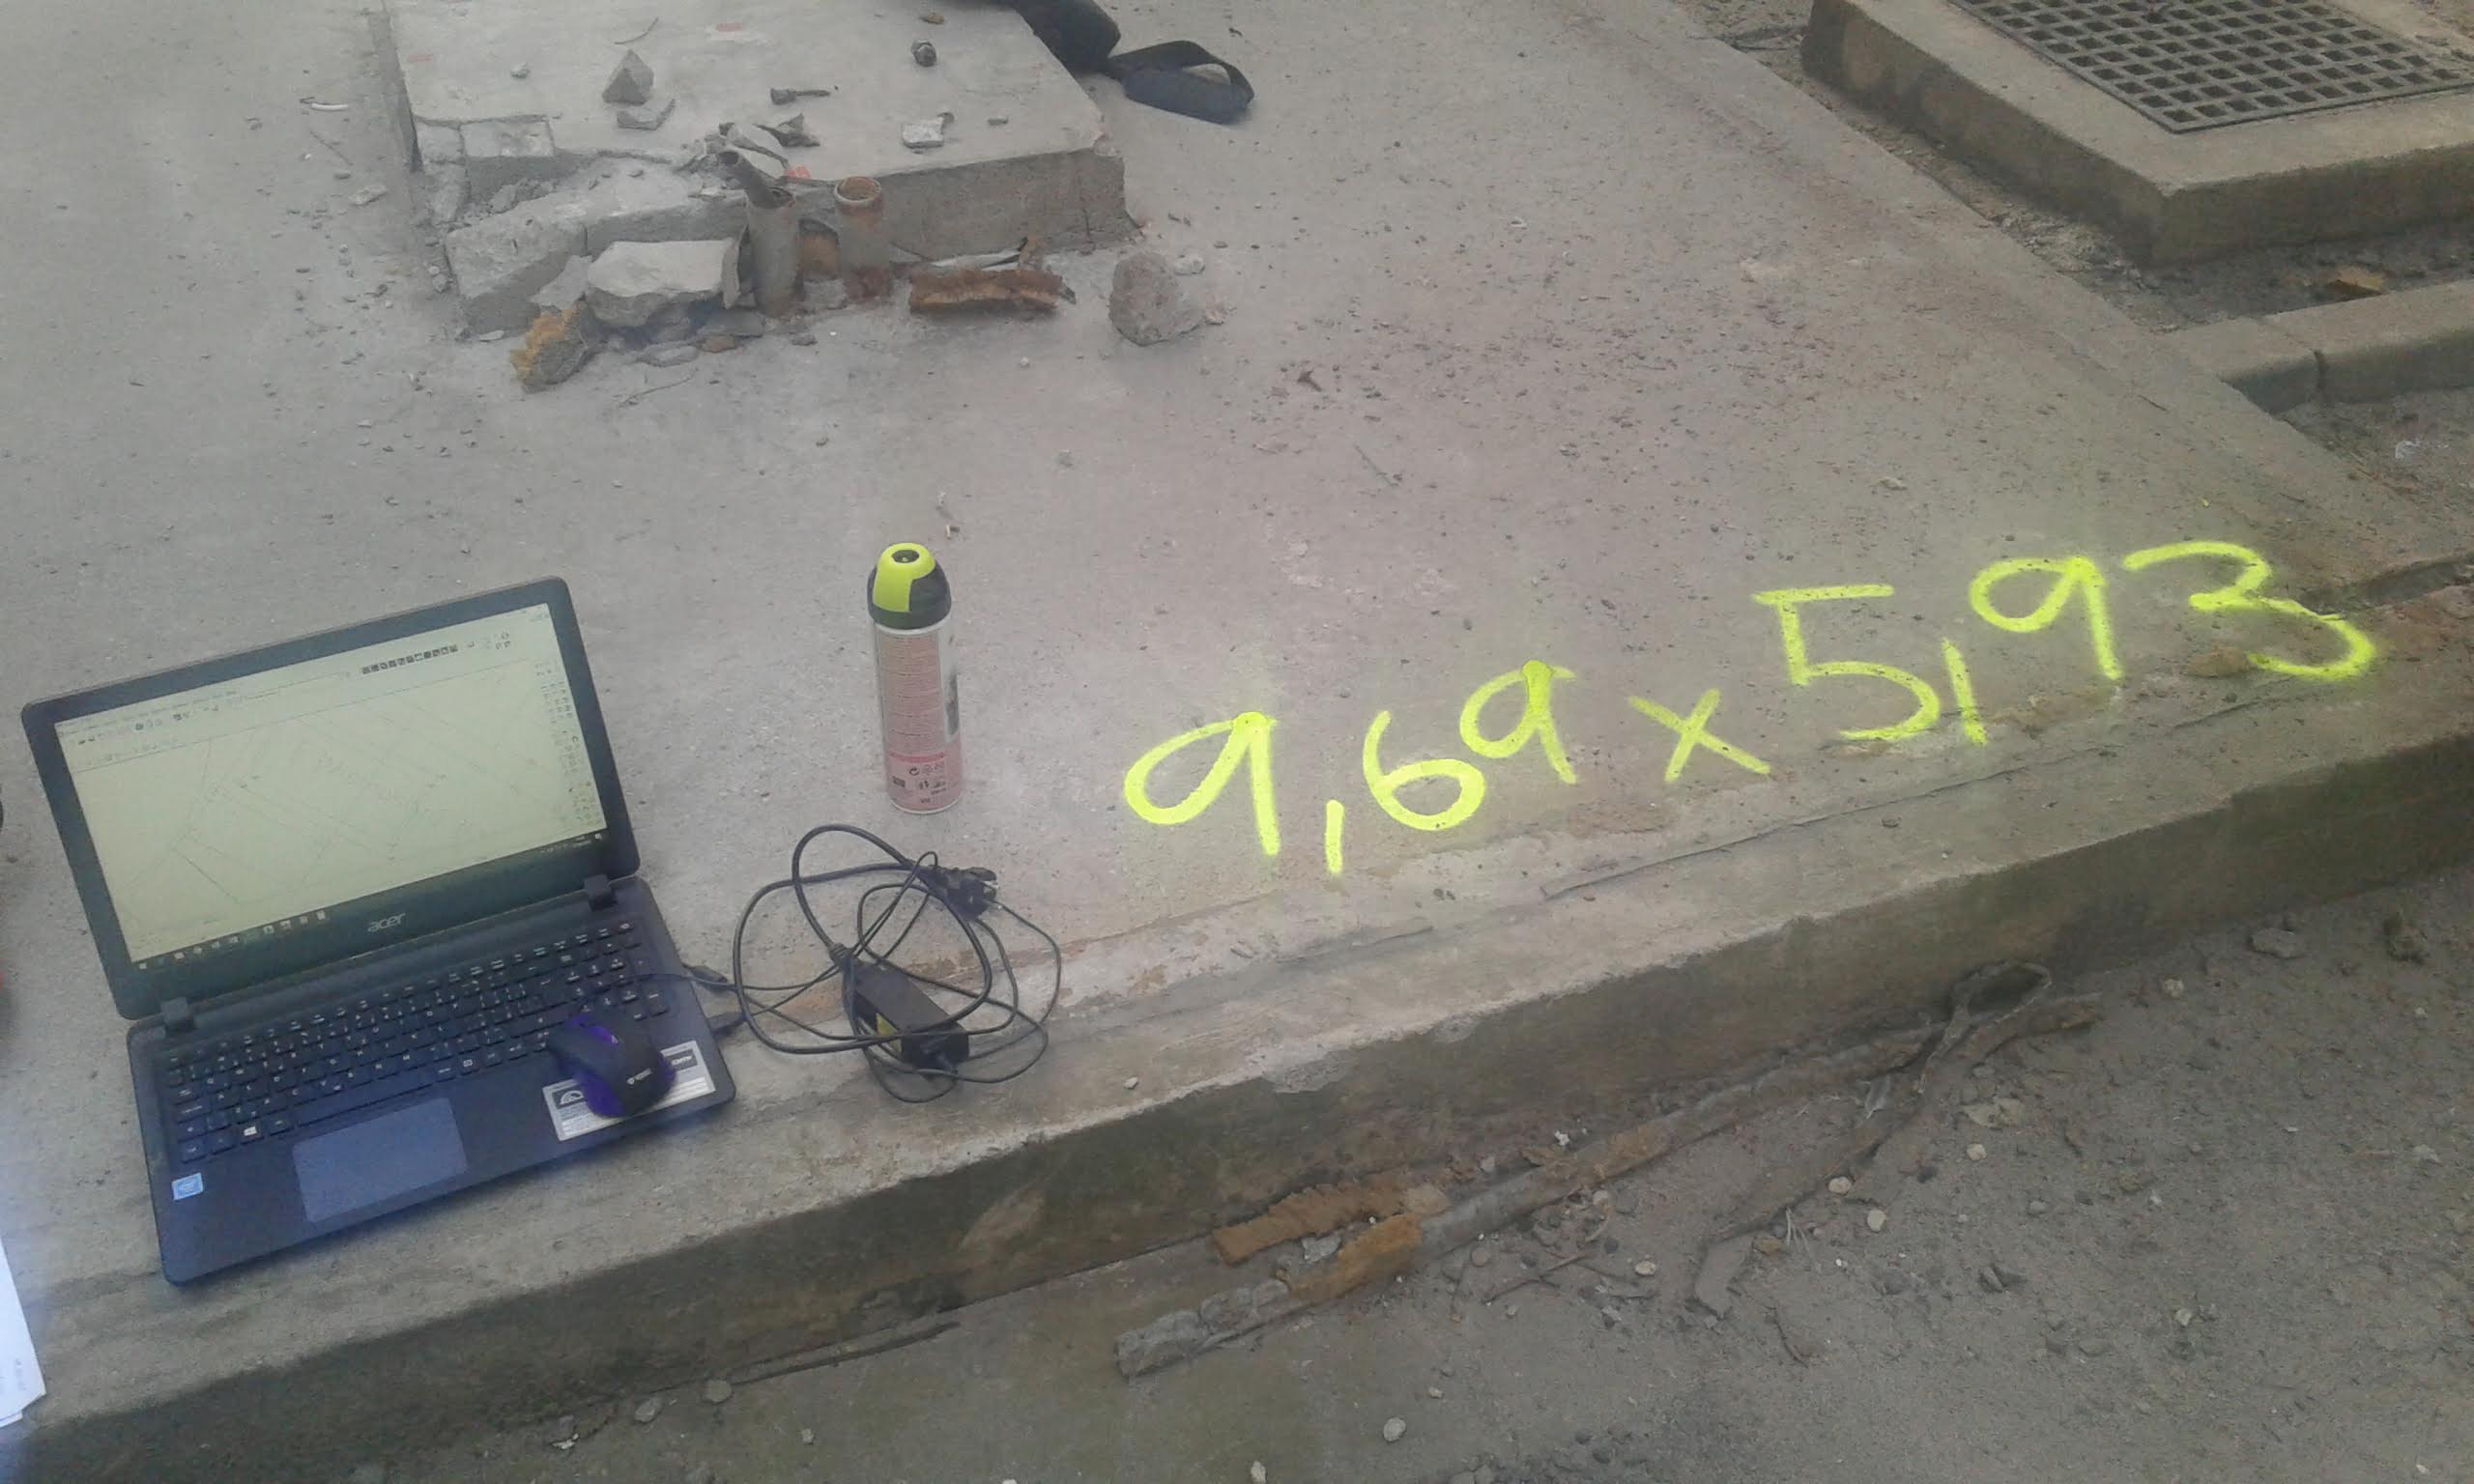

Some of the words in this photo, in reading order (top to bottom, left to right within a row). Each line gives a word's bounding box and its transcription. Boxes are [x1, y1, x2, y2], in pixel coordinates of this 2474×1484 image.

[1124, 659, 1576, 873] 9,69
[1752, 541, 2377, 747] 5,93
[367, 912, 406, 932] acer
